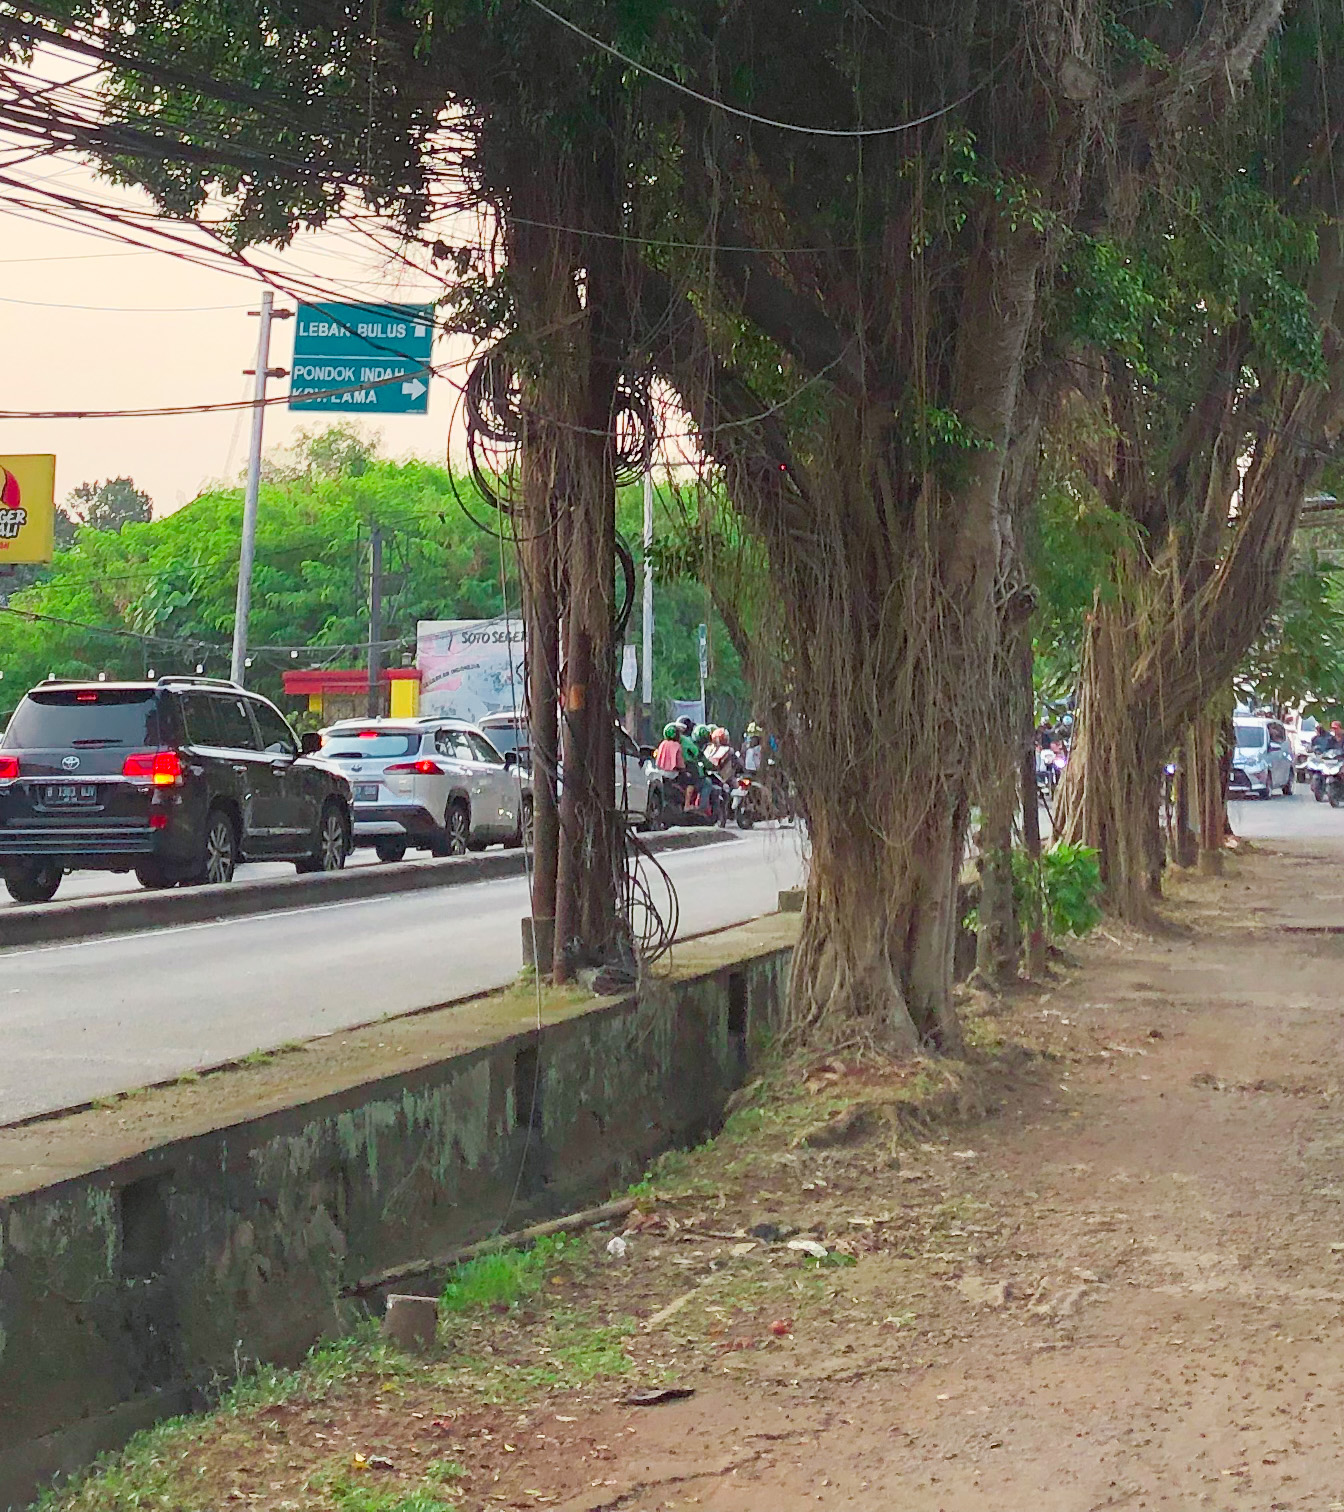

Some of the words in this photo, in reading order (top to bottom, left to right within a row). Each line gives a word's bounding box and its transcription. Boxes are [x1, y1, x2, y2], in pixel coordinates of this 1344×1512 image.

[299, 322, 351, 337] LEBAK
[358, 323, 406, 338] BULUS
[294, 366, 355, 381] PONDOK
[360, 367, 405, 382] INDAH
[331, 389, 377, 404] LAMA
[461, 631, 490, 644] SOTO
